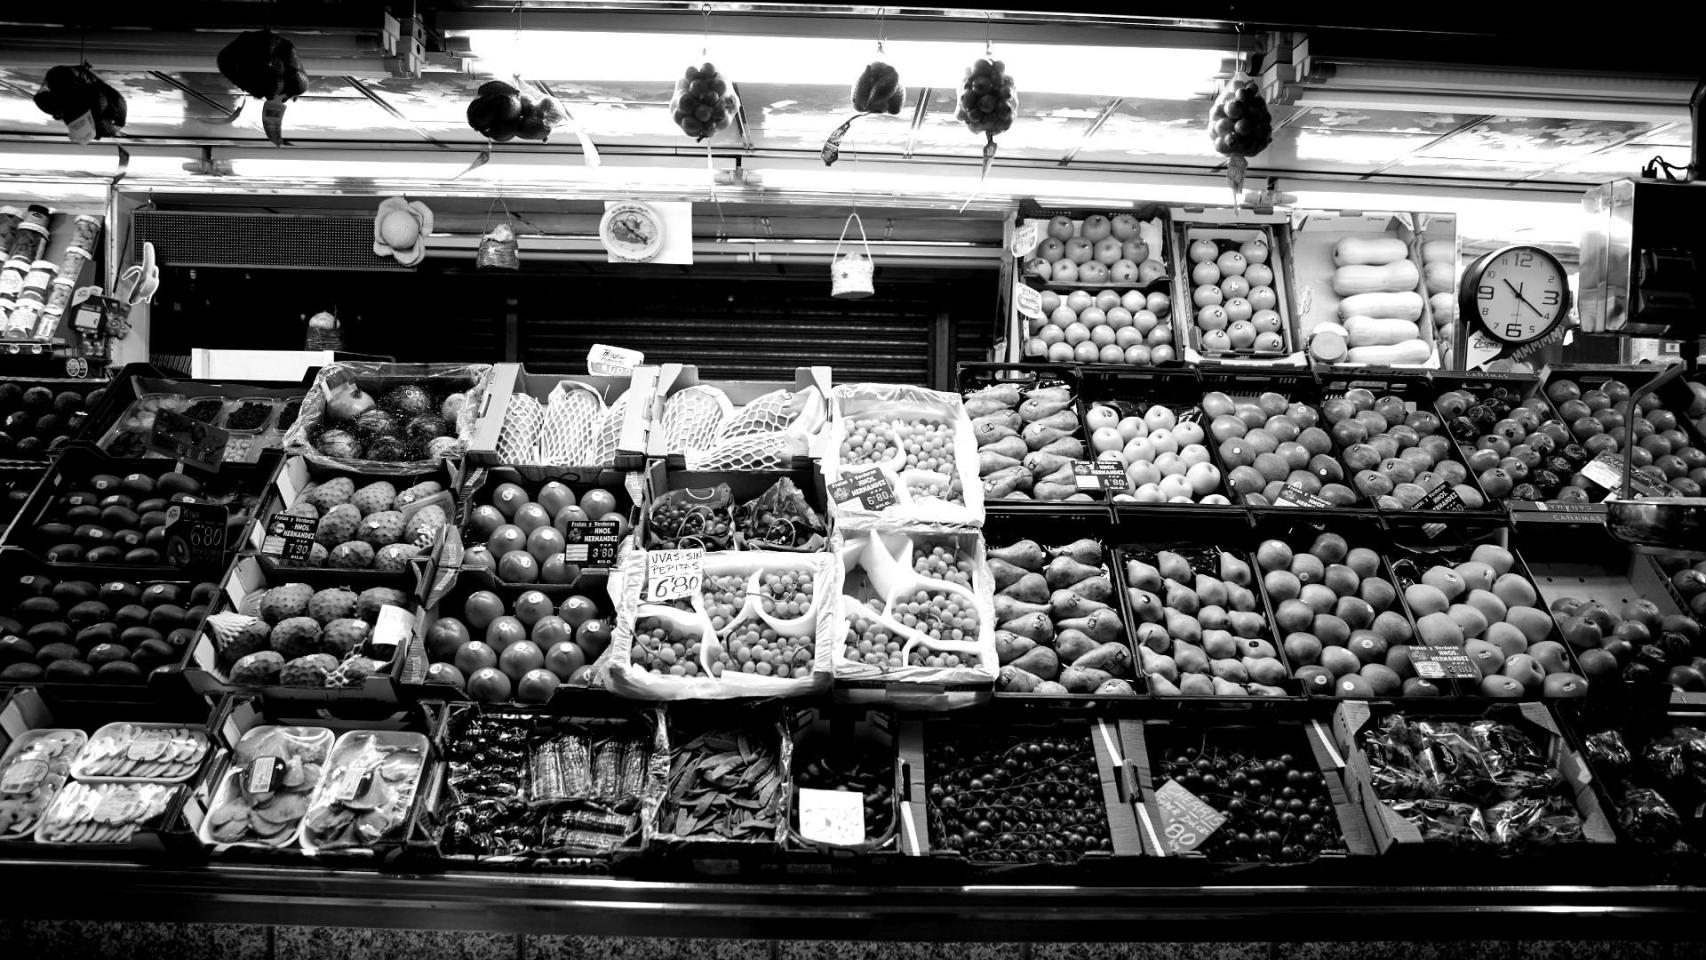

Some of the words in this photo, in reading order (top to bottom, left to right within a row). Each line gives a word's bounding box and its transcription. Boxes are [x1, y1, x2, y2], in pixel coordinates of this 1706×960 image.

[1514, 253, 1533, 268] 12
[1487, 270, 1495, 278] 10
[1548, 275, 1555, 283] 2
[1478, 285, 1495, 300] 9
[1542, 290, 1560, 305] 3
[1482, 307, 1489, 316] 8
[1505, 323, 1522, 338] 6
[1529, 325, 1535, 333] 5
[851, 479, 887, 497] HERNANDEZ
[283, 530, 316, 540] HERNANDEZ
[1166, 785, 1224, 826] CHERRIS
